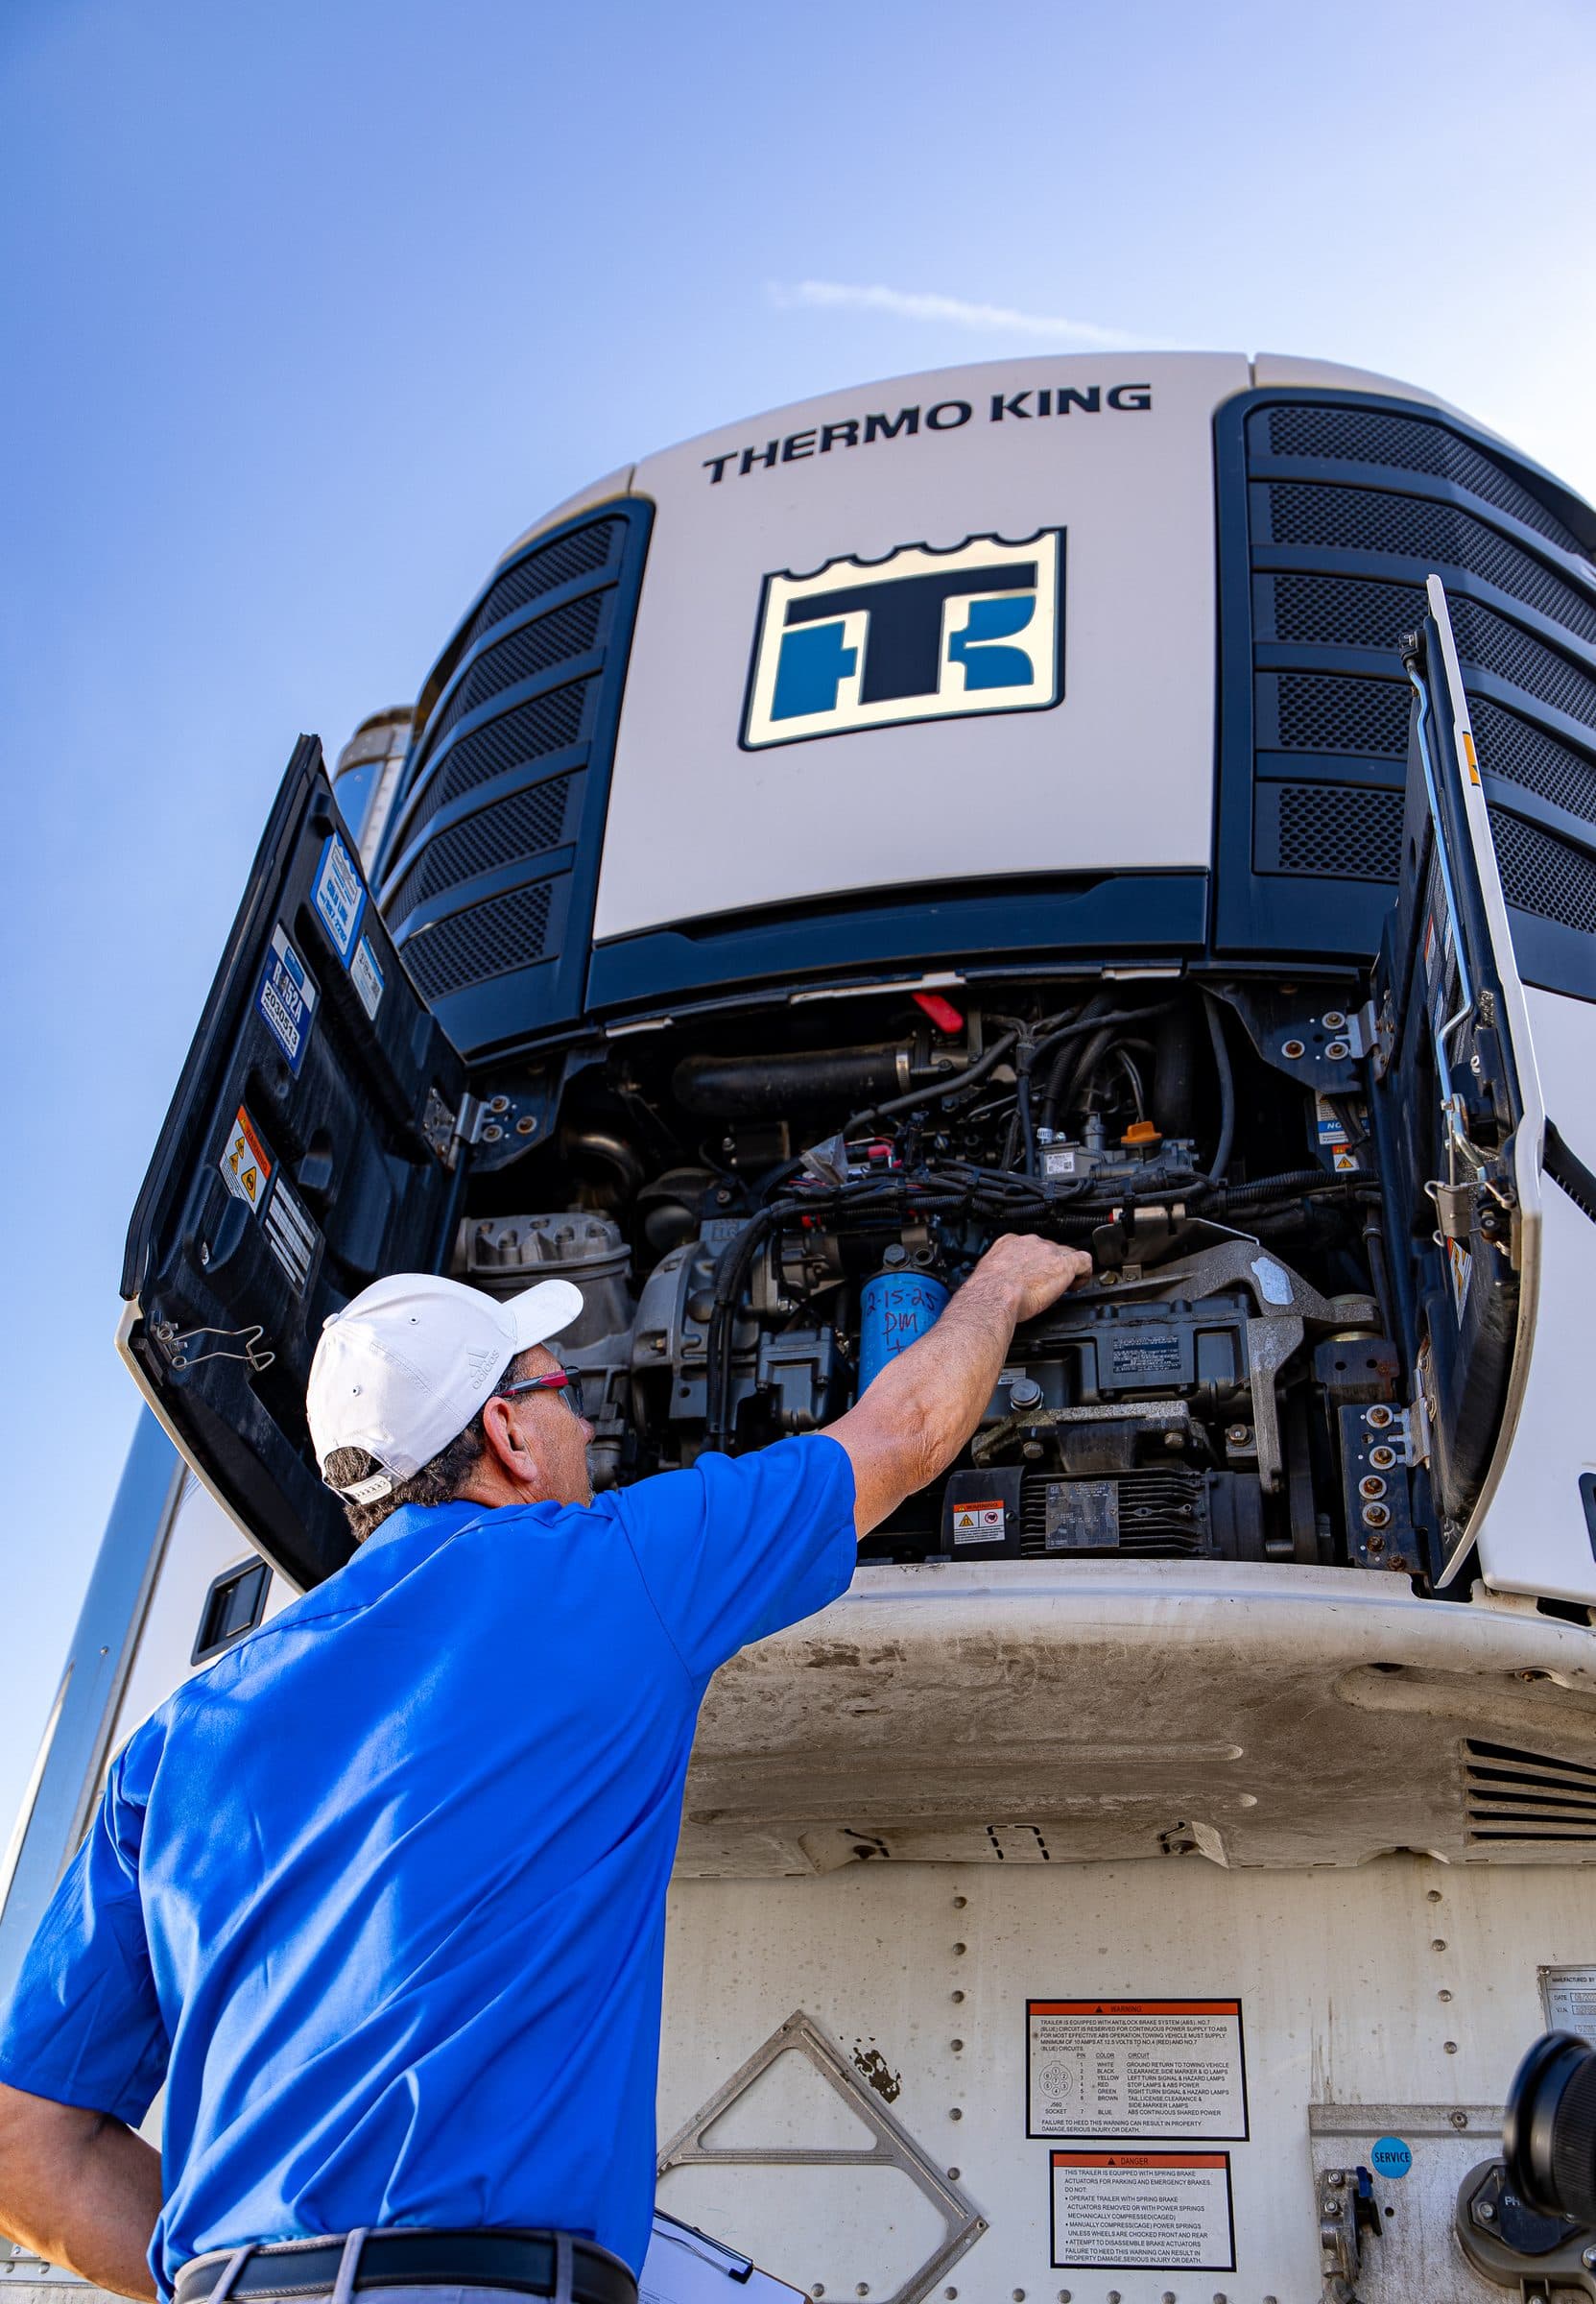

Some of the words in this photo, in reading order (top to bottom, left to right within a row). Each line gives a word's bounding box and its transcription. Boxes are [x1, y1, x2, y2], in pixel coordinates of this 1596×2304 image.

[702, 399, 972, 486] THERMO
[989, 382, 1153, 422] KING
[265, 986, 298, 1045] 2030513
[246, 1129, 268, 1172] WARNING
[470, 1350, 499, 1390] adidas
[1374, 2150, 1411, 2164] SERVICE
